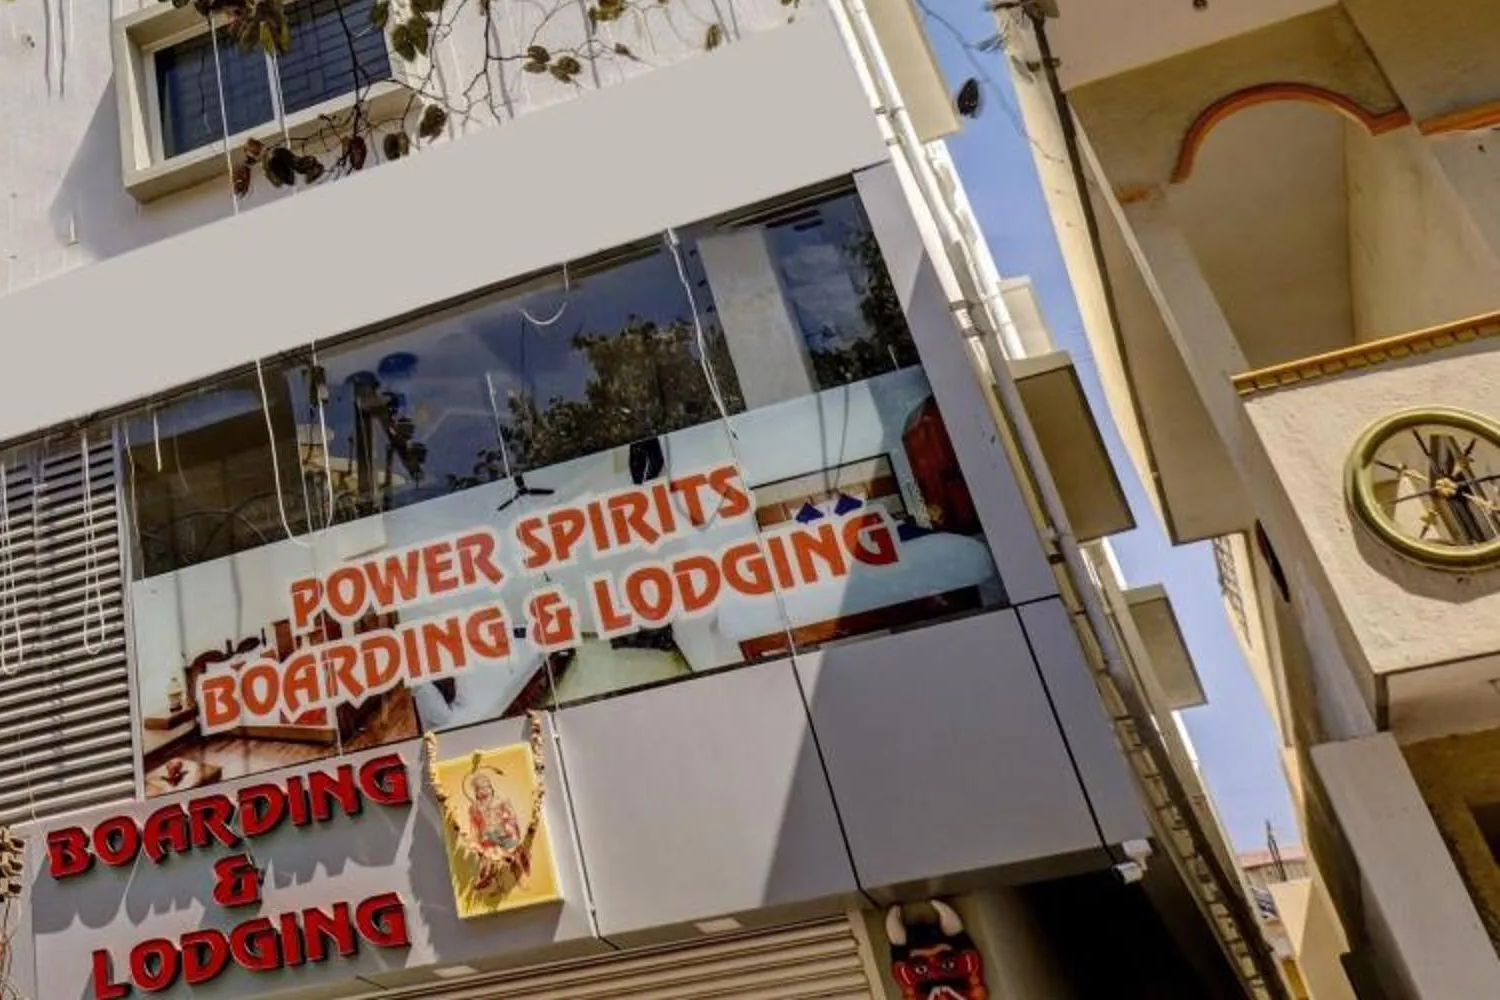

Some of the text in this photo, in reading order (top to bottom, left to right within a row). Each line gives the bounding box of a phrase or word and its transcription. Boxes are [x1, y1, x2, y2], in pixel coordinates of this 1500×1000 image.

[290, 465, 750, 629] POWER SPIRITS
[201, 511, 899, 729] BOARDING & LODGING
[46, 753, 412, 880] BOARDING
[212, 853, 264, 909] &
[91, 892, 412, 1000] LODGING
